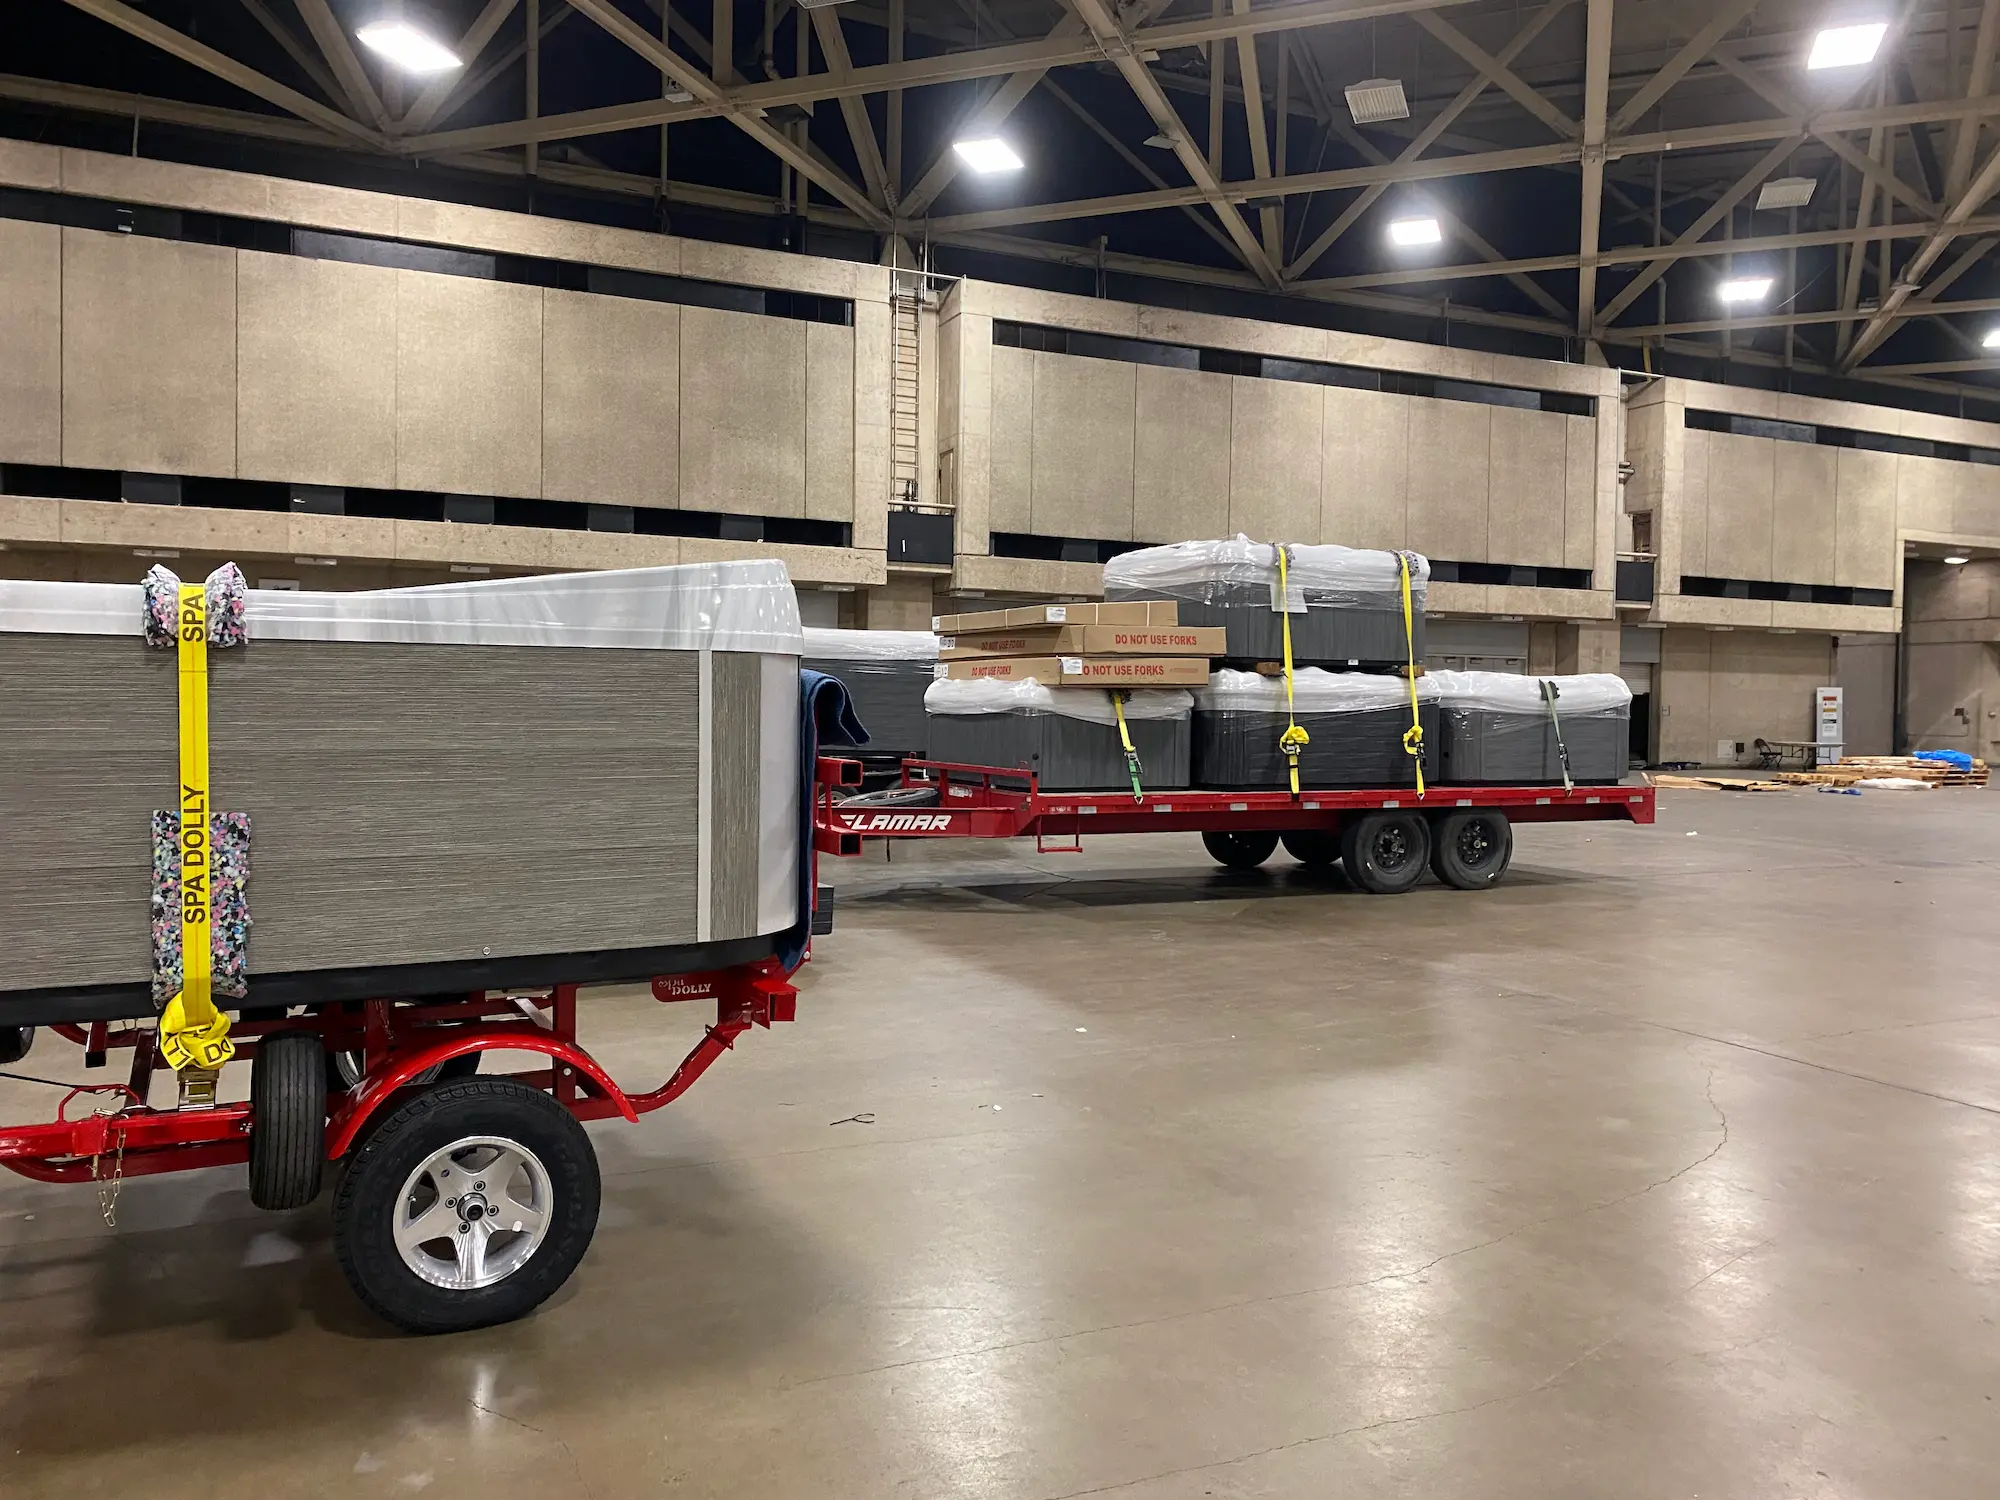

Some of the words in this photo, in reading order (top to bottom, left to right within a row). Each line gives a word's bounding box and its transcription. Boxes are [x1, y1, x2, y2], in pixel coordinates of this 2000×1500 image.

[182, 593, 204, 643] SPA
[1115, 634, 1128, 644] DO
[1130, 634, 1148, 645] NOT
[1150, 635, 1168, 645] USE
[1169, 635, 1198, 646] FORKS
[971, 667, 978, 676] DO
[988, 666, 997, 676] USE
[1083, 665, 1090, 676] O
[1092, 665, 1112, 676] NOT
[1114, 665, 1133, 676] USE
[1134, 665, 1165, 676] FORKS
[182, 784, 205, 867] DOLLY
[850, 814, 952, 831] LAMAR
[183, 873, 206, 924] SPA
[671, 983, 712, 996] DOLLY
